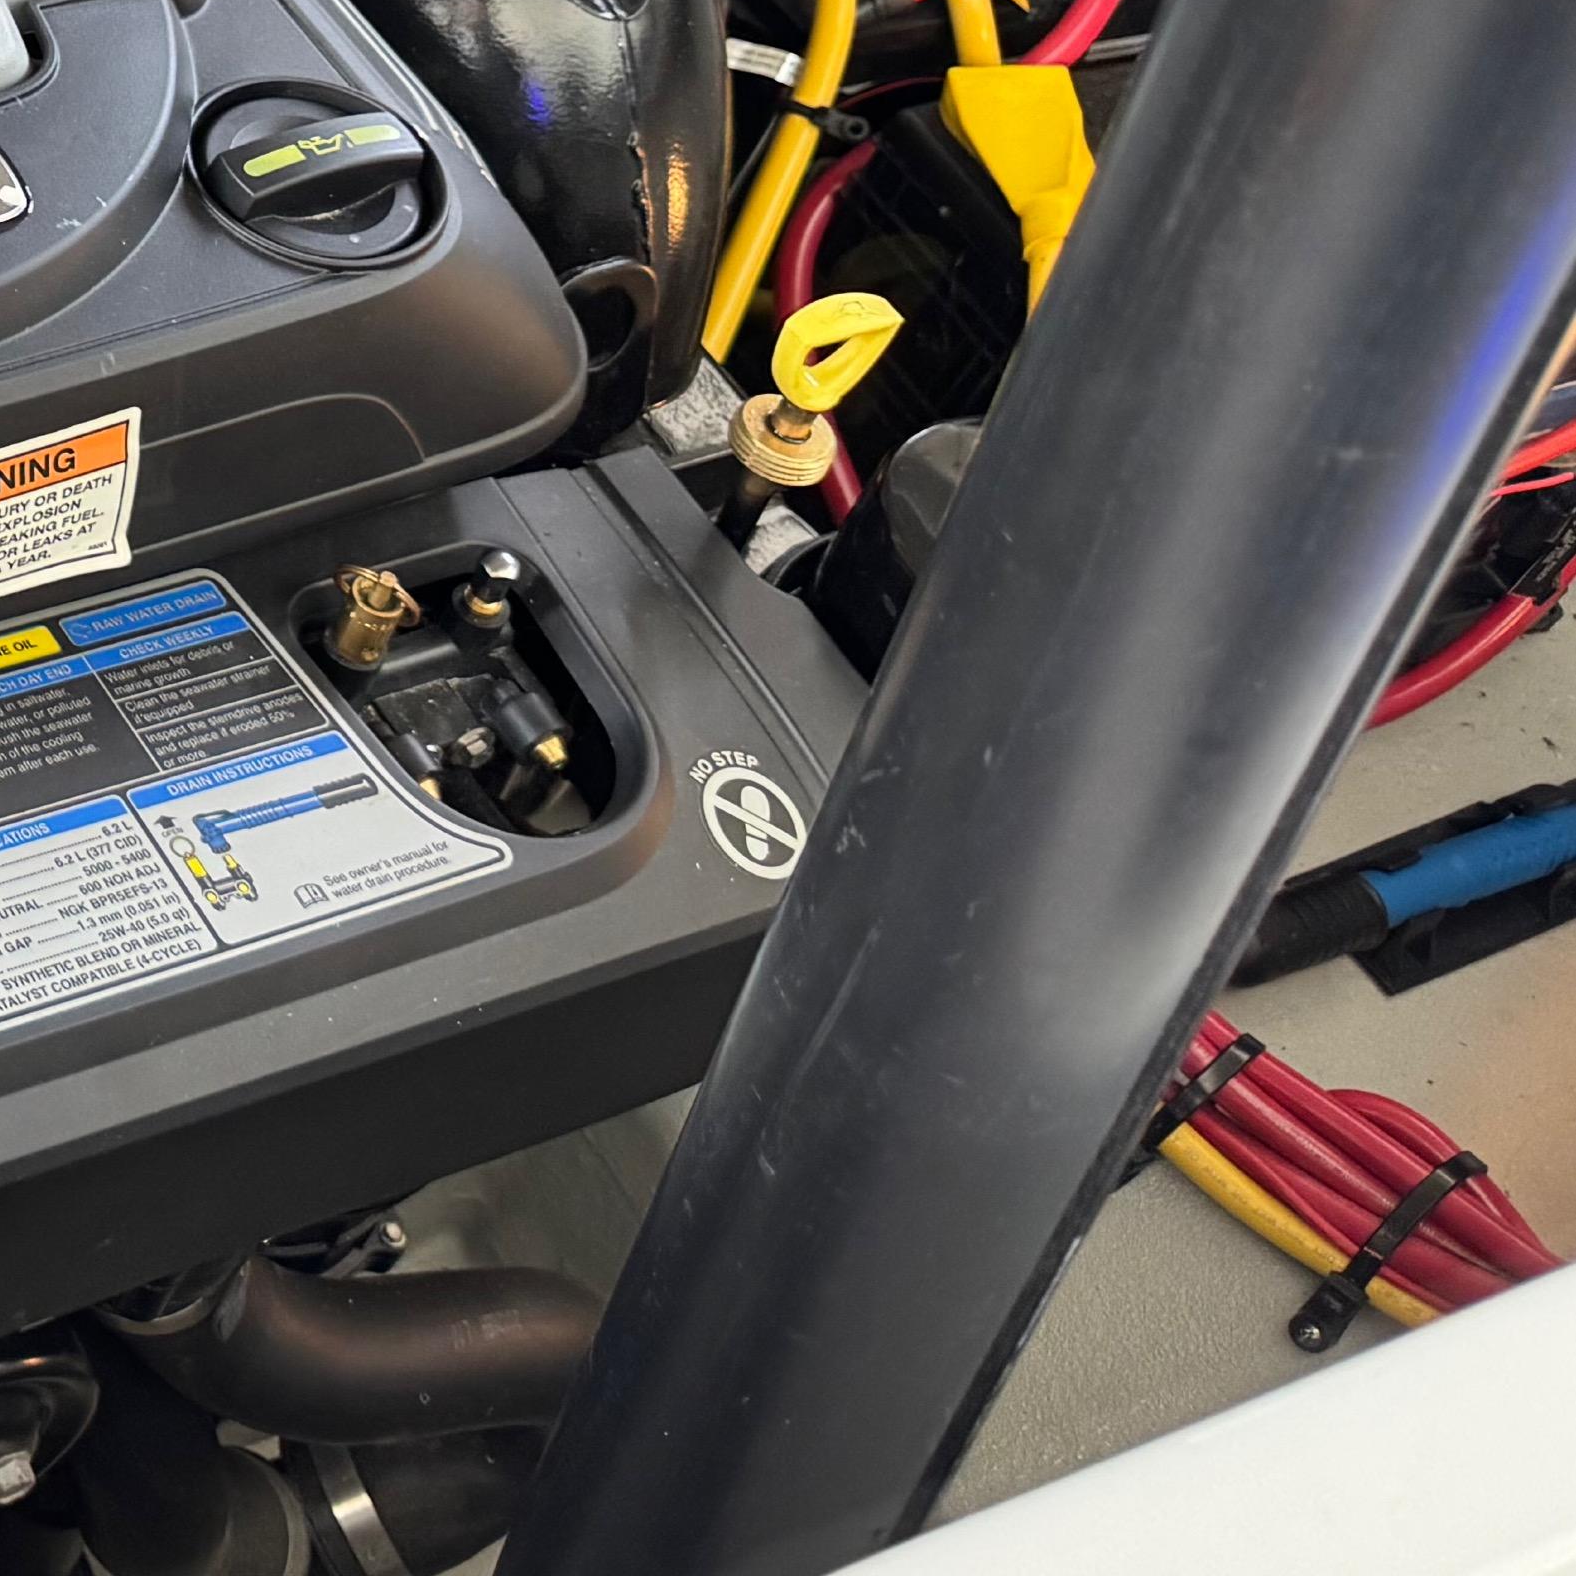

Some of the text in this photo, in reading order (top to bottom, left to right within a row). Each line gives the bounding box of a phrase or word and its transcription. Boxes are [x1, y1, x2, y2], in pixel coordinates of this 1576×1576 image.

[34, 494, 57, 509] OR
[62, 475, 113, 500] DEATH
[62, 509, 105, 529] FUEL.
[22, 529, 73, 555] LEAKS
[78, 523, 96, 538] AT
[7, 550, 51, 570] YEAR.
[91, 590, 217, 632] RAW WATER DRAIN
[13, 640, 37, 652] OIL
[119, 625, 214, 659] CHECK WEEKLY
[17, 672, 43, 687] DAY
[44, 664, 72, 680] END
[166, 745, 313, 796] DRAIN INSTRUCTIONS
[689, 751, 759, 784] NO STEP
[101, 823, 122, 837] 6.2
[121, 820, 133, 831] L
[54, 854, 75, 868] 6.2
[74, 851, 86, 862] L
[86, 842, 111, 860] (377
[114, 834, 143, 850] CID)
[82, 860, 113, 877] 5000
[121, 848, 151, 865] 5400
[79, 880, 103, 895] 600
[102, 870, 134, 888] NON
[135, 862, 161, 879] ADJ
[4, 936, 32, 953] GAP
[77, 917, 97, 931] 1.3
[98, 911, 123, 925] mm
[123, 898, 161, 918] (0.051
[57, 901, 89, 919] NGK
[98, 920, 145, 942] 25W-40
[146, 912, 170, 930] (5.0
[1, 960, 75, 990] SYNTHETIC
[75, 946, 121, 968] BLEND
[121, 939, 143, 953] OR
[142, 921, 202, 947] MINERAL
[51, 958, 136, 993] COMPATIBLE
[136, 938, 202, 968] (4-CYCLE)
